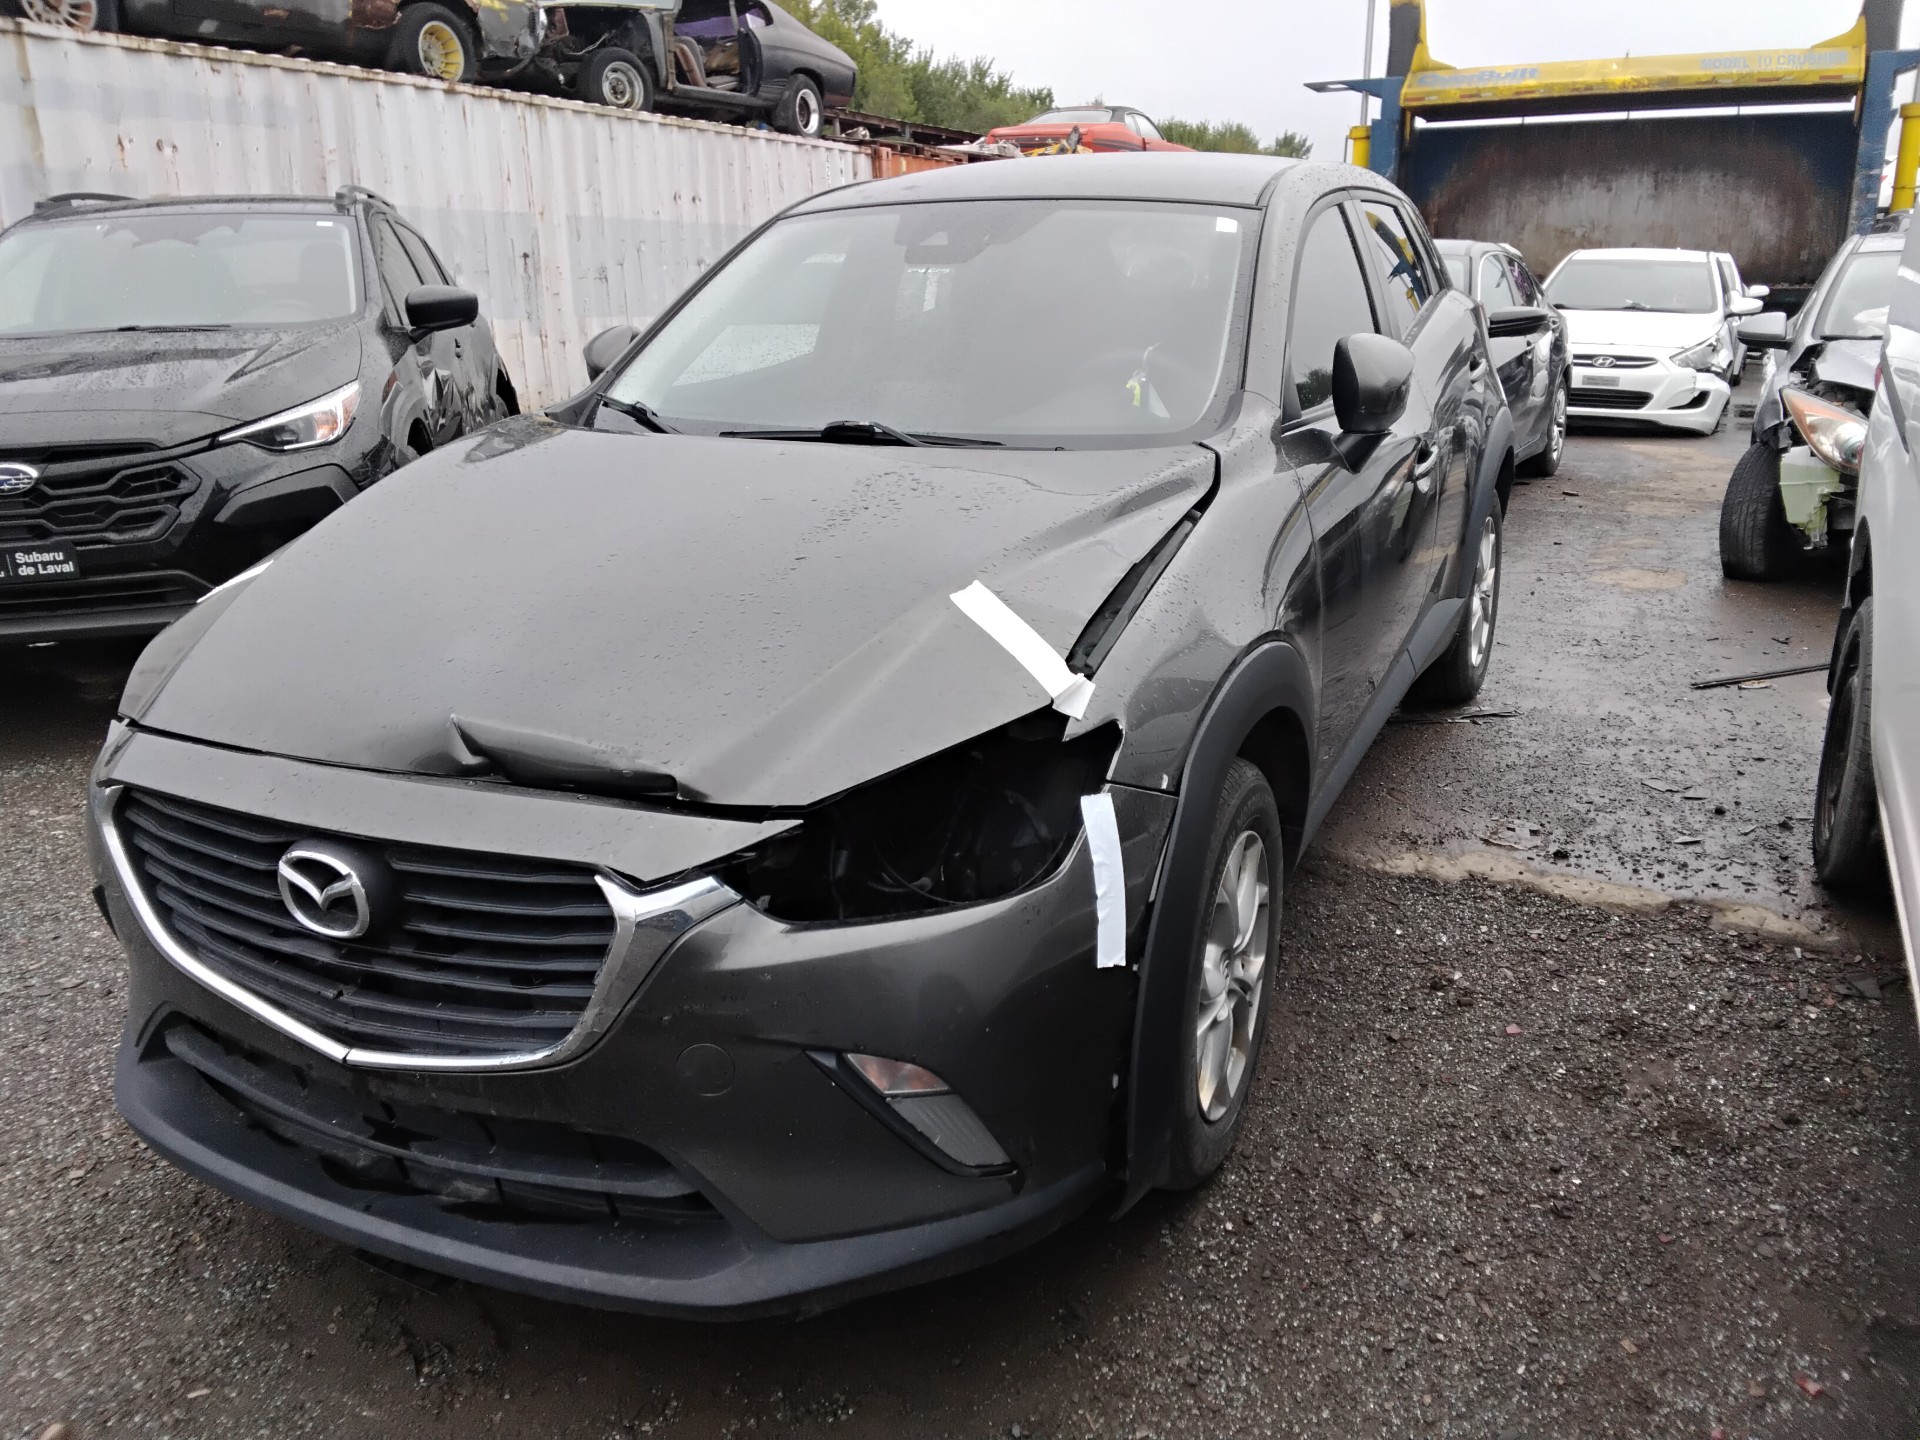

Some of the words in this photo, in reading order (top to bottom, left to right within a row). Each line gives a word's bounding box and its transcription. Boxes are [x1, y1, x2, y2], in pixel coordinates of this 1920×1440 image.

[1700, 57, 1750, 70] MODEL
[1757, 55, 1772, 67] 10
[15, 551, 64, 564] Subaru
[18, 564, 36, 576] de
[37, 561, 75, 575] Laval
